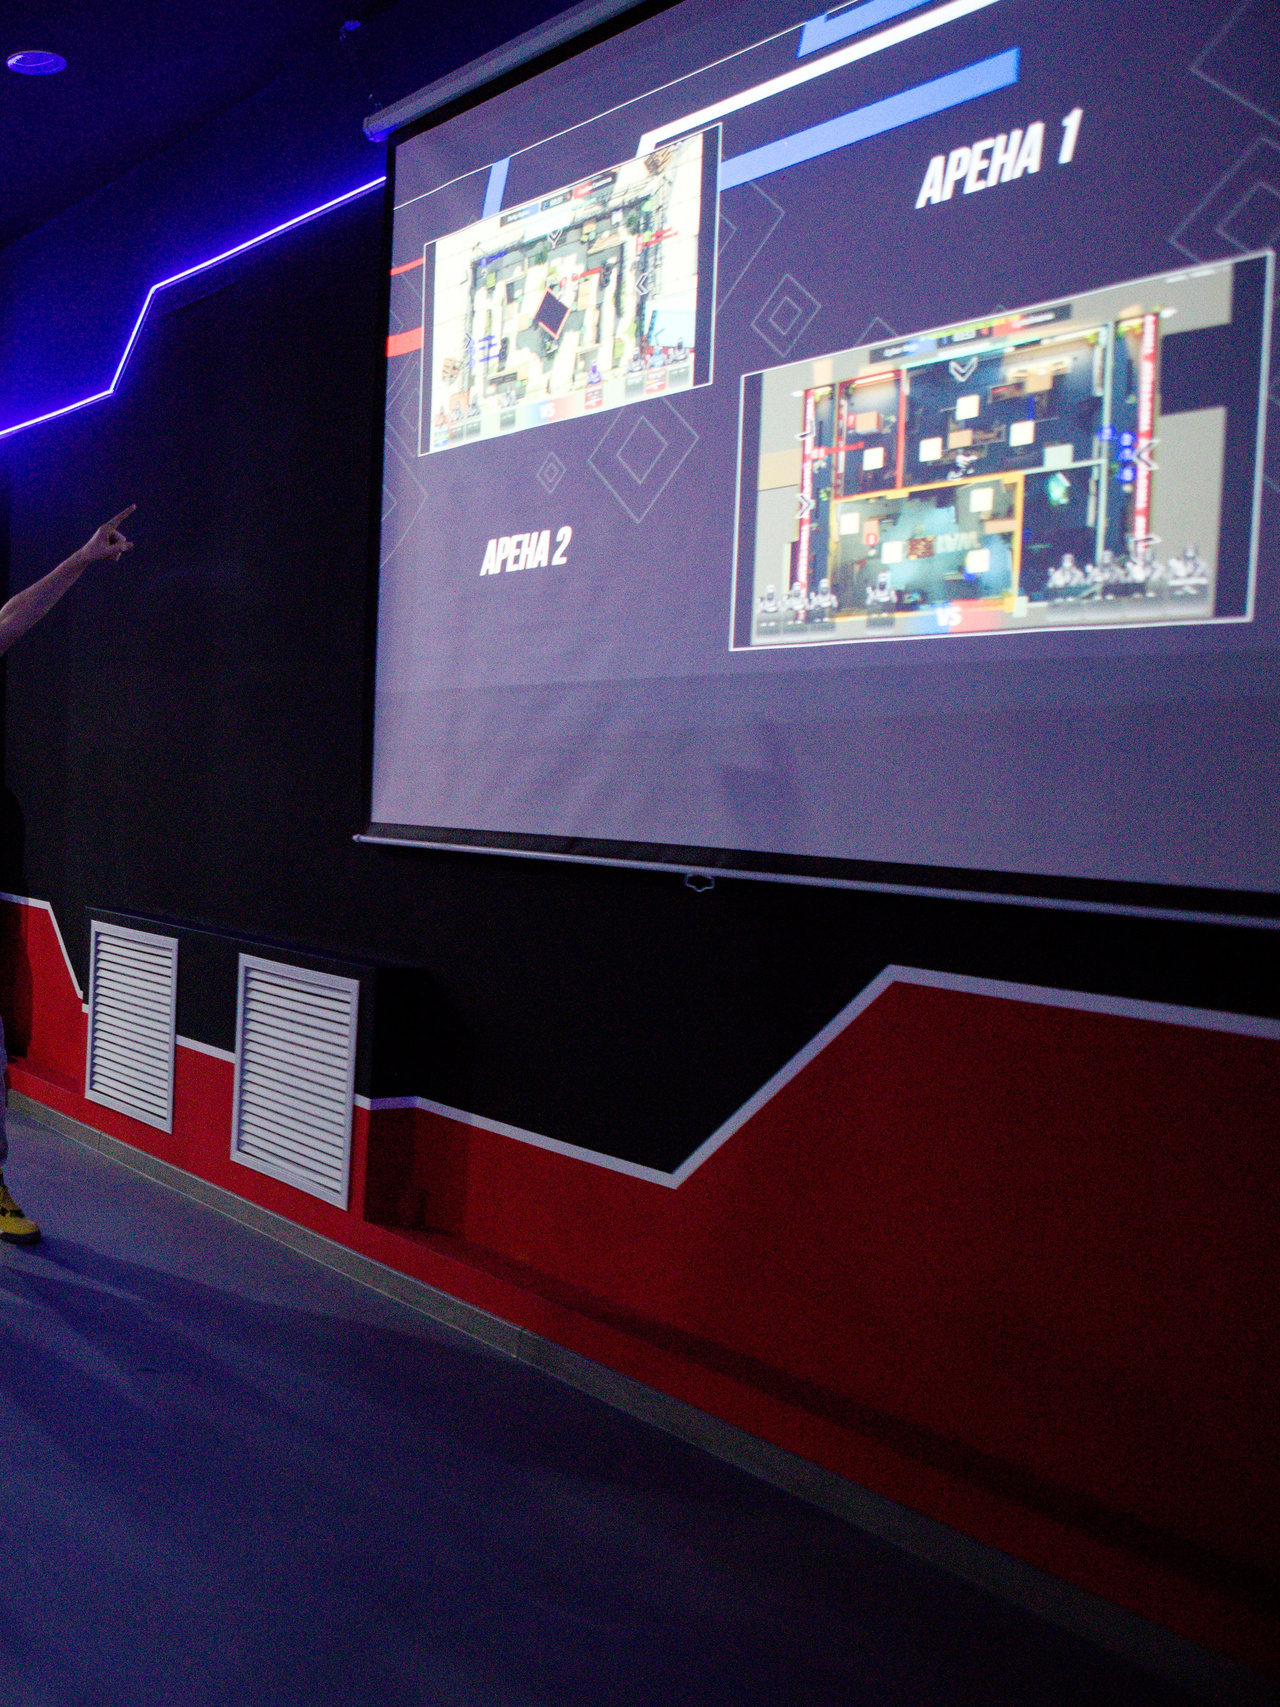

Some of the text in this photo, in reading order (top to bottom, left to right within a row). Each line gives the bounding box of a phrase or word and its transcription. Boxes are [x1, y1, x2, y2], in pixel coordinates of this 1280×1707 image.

[915, 106, 1084, 210] АРЕНА 1
[480, 525, 573, 576] АРЕНА 2
[936, 606, 963, 626] VS
